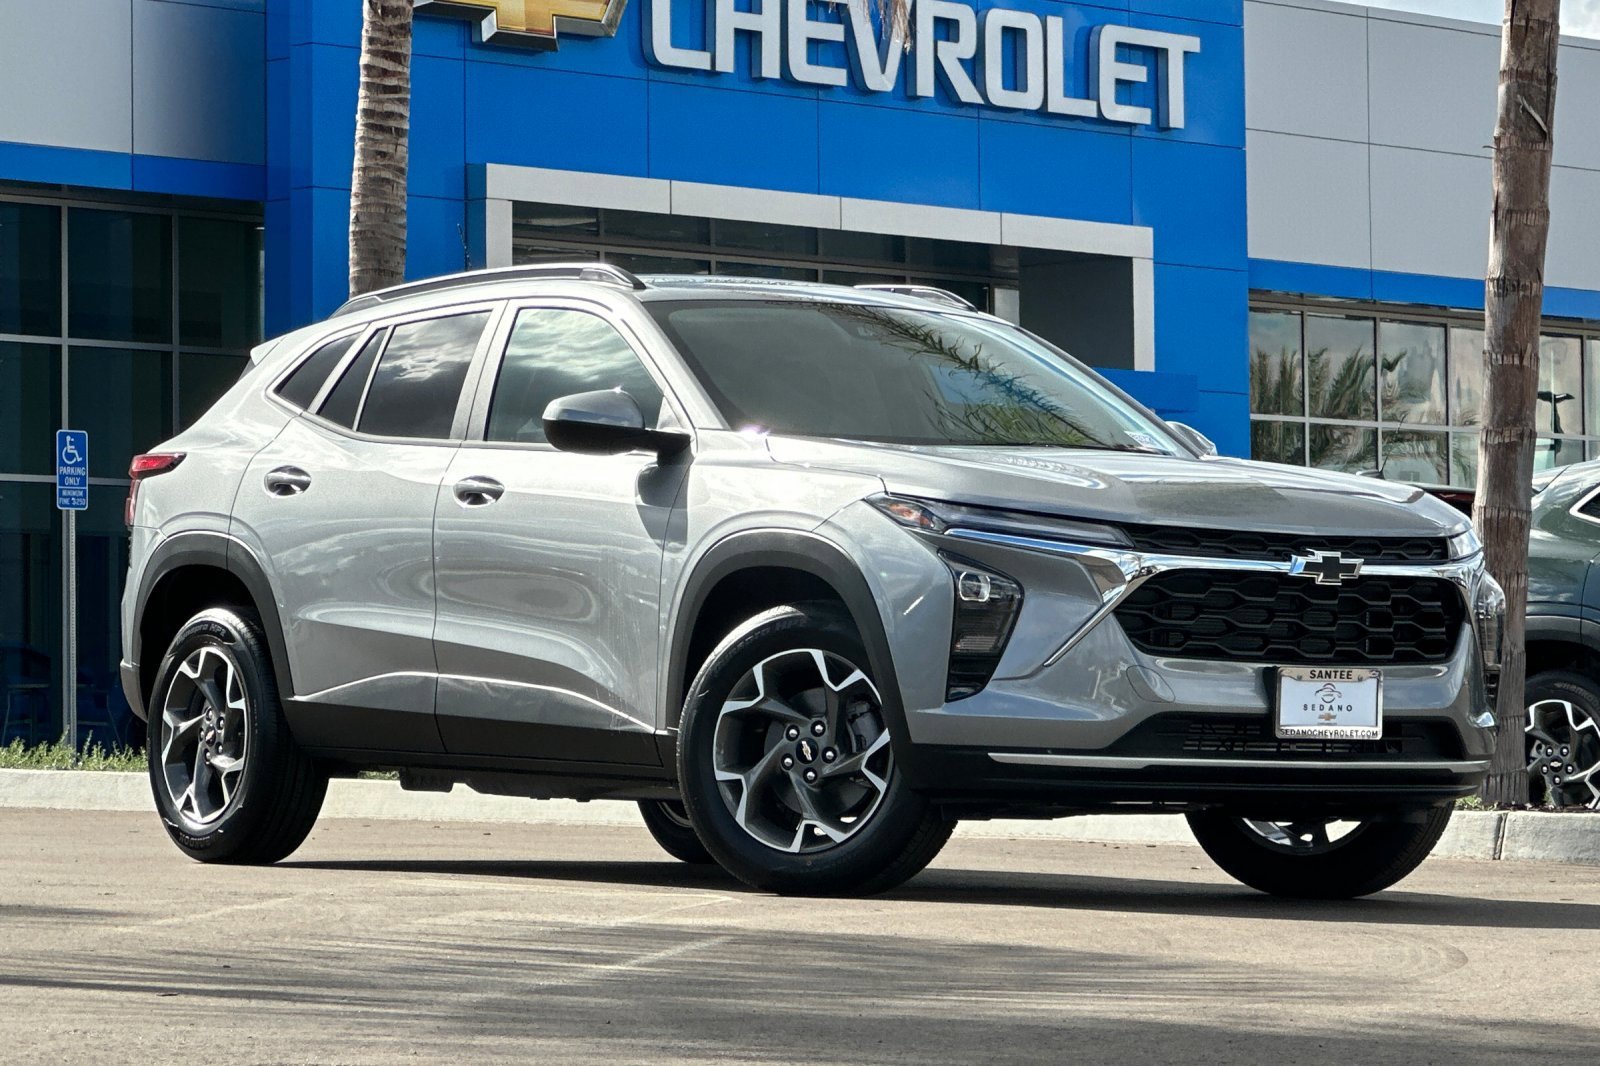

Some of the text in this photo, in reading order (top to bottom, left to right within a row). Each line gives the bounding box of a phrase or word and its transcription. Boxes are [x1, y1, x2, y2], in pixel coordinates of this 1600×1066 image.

[643, 0, 1201, 129] CHEVROLET
[59, 466, 86, 476] PARKING
[64, 477, 81, 486] ONLY
[1309, 669, 1353, 680] SANTEE
[1303, 703, 1353, 712] SEDANO
[1280, 728, 1379, 738] SEDANOCHEVROLET.COM
